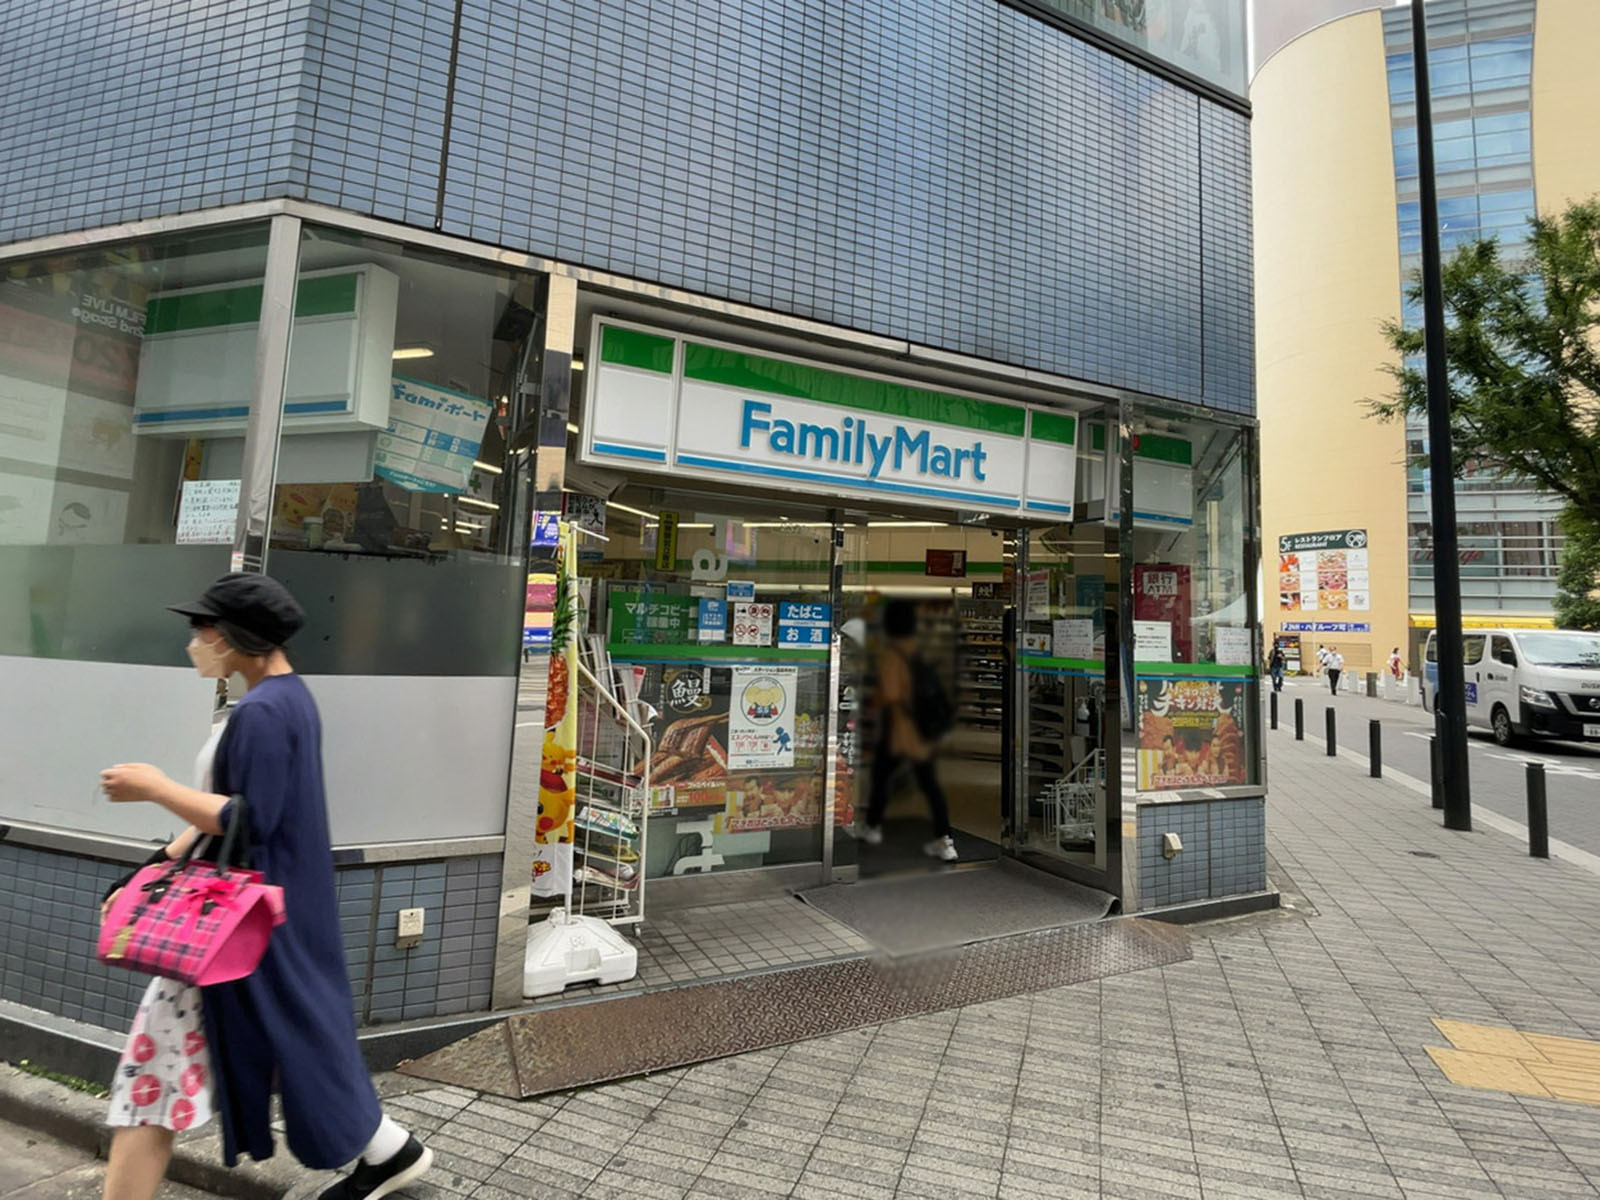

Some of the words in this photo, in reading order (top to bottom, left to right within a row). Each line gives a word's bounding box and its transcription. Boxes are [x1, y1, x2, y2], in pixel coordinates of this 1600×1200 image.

[740, 400, 987, 481] FamilyMart
[1147, 585, 1173, 593] ATM
[787, 604, 823, 619] たばこ
[670, 678, 702, 708] 鰻
